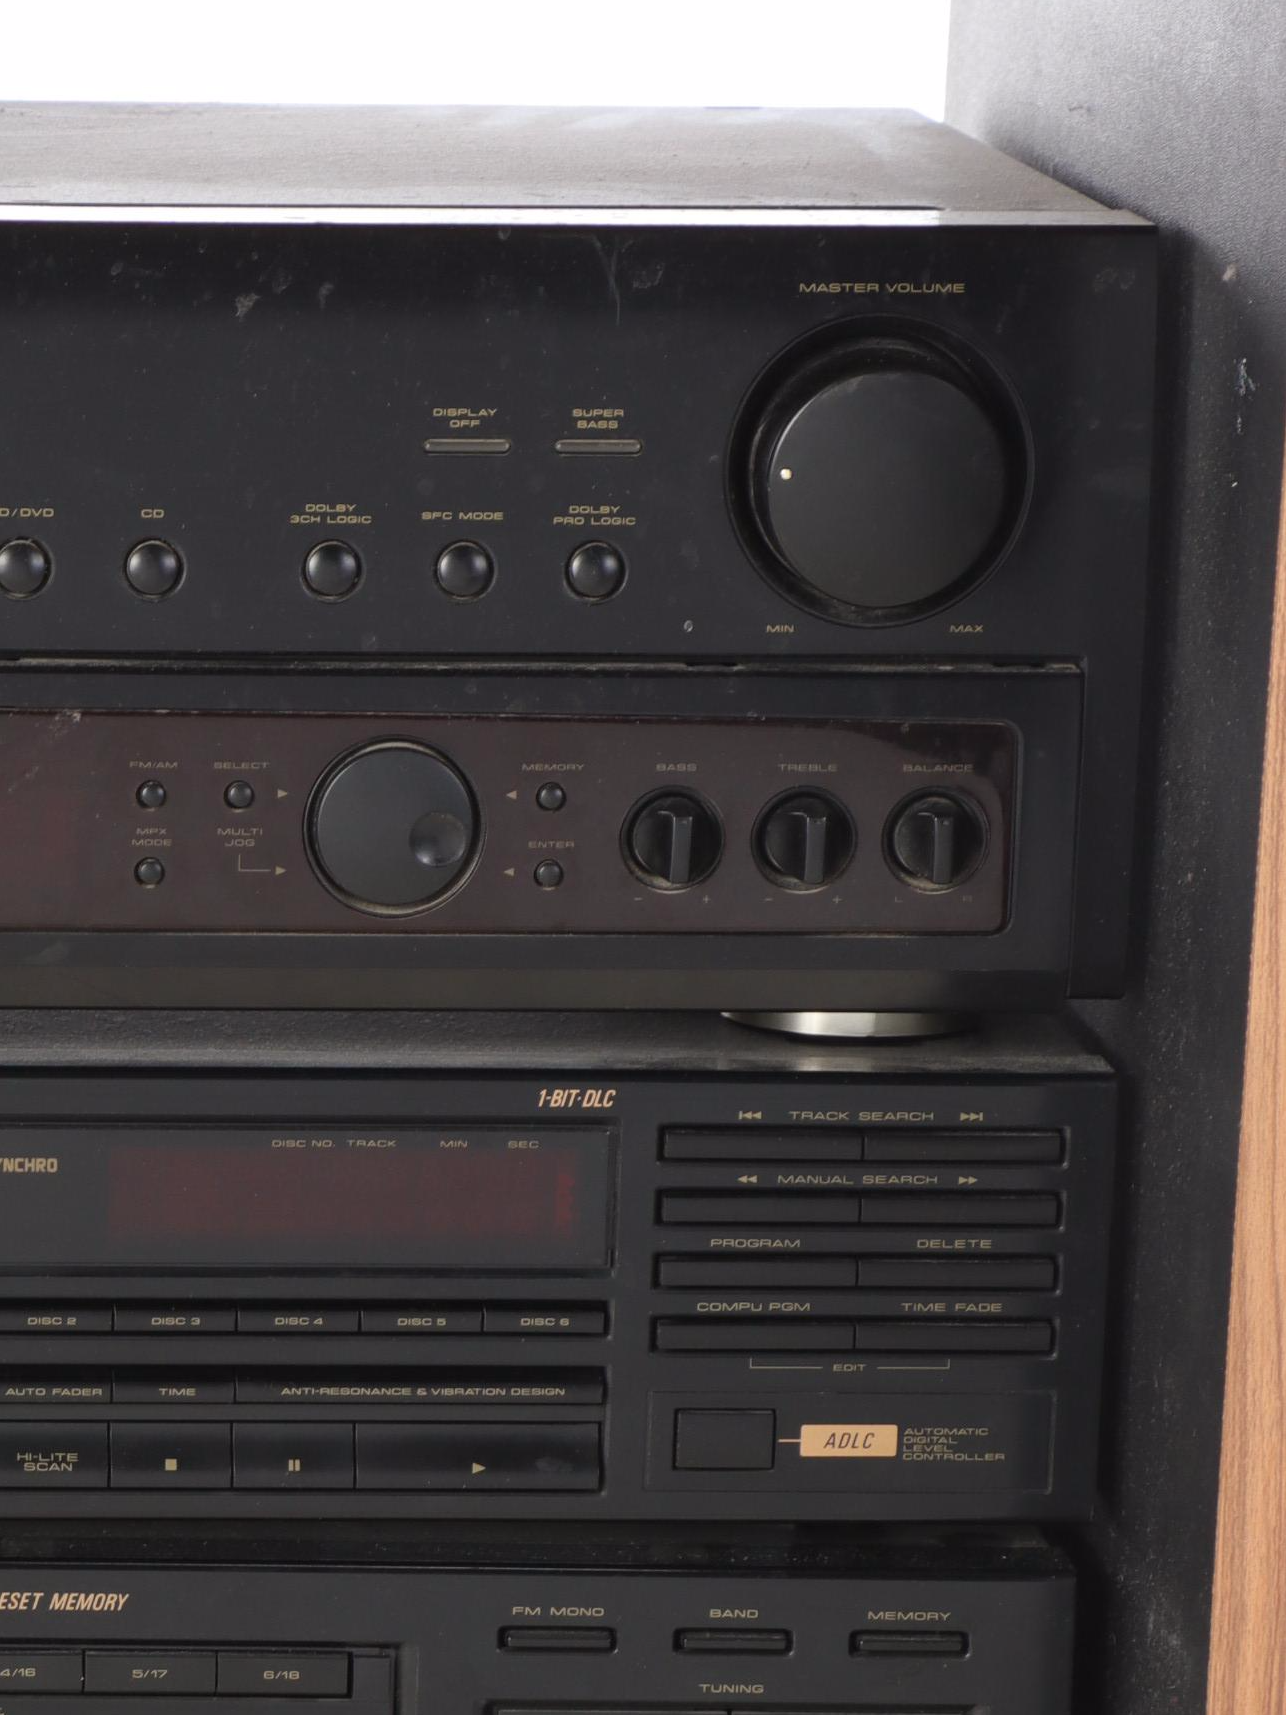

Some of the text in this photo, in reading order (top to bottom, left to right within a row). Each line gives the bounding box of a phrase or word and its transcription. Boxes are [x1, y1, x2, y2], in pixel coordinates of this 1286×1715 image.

[799, 282, 965, 294] MASTER VOLUME
[432, 407, 498, 417] DISPLAY
[572, 408, 625, 418] SUPER
[449, 419, 481, 428] OFF
[304, 503, 357, 513] DOLBY
[568, 505, 621, 515] DOLBY
[140, 508, 165, 519] CD
[458, 511, 504, 521] MODE
[326, 515, 372, 524] LOGIC
[552, 516, 636, 526] PRO LOGIC
[788, 1110, 934, 1122] TRACK SEARCH
[347, 1139, 396, 1148] TRACK
[439, 1140, 468, 1148] MIN
[777, 1174, 938, 1185] MANUAL SEARCH
[710, 1238, 801, 1248] PROGRAM
[916, 1239, 992, 1249] DELETE
[696, 1301, 811, 1312] COMPU PGM
[900, 1302, 1002, 1313] TIME FADE
[27, 1316, 63, 1326] DISC
[150, 1316, 187, 1326] DISC
[274, 1316, 310, 1326] DISC
[397, 1317, 433, 1327] DISC
[520, 1317, 556, 1327] DISC
[4, 1387, 103, 1397] AUTO FADER
[158, 1387, 196, 1397] TIME
[430, 1387, 566, 1397] VIBRATION DESIGN
[903, 1427, 989, 1436] AUTOMATIC
[823, 1432, 875, 1449] ADLC
[16, 1452, 79, 1462] HI-LITE
[902, 1452, 1005, 1461] CONTROLLER
[23, 1462, 73, 1472] SCAN
[48, 1592, 130, 1611] MEMORY
[512, 1606, 605, 1617] FM MONO
[709, 1608, 759, 1619] BAND
[867, 1611, 951, 1621] MEMORY
[698, 1683, 765, 1694] TUNING
